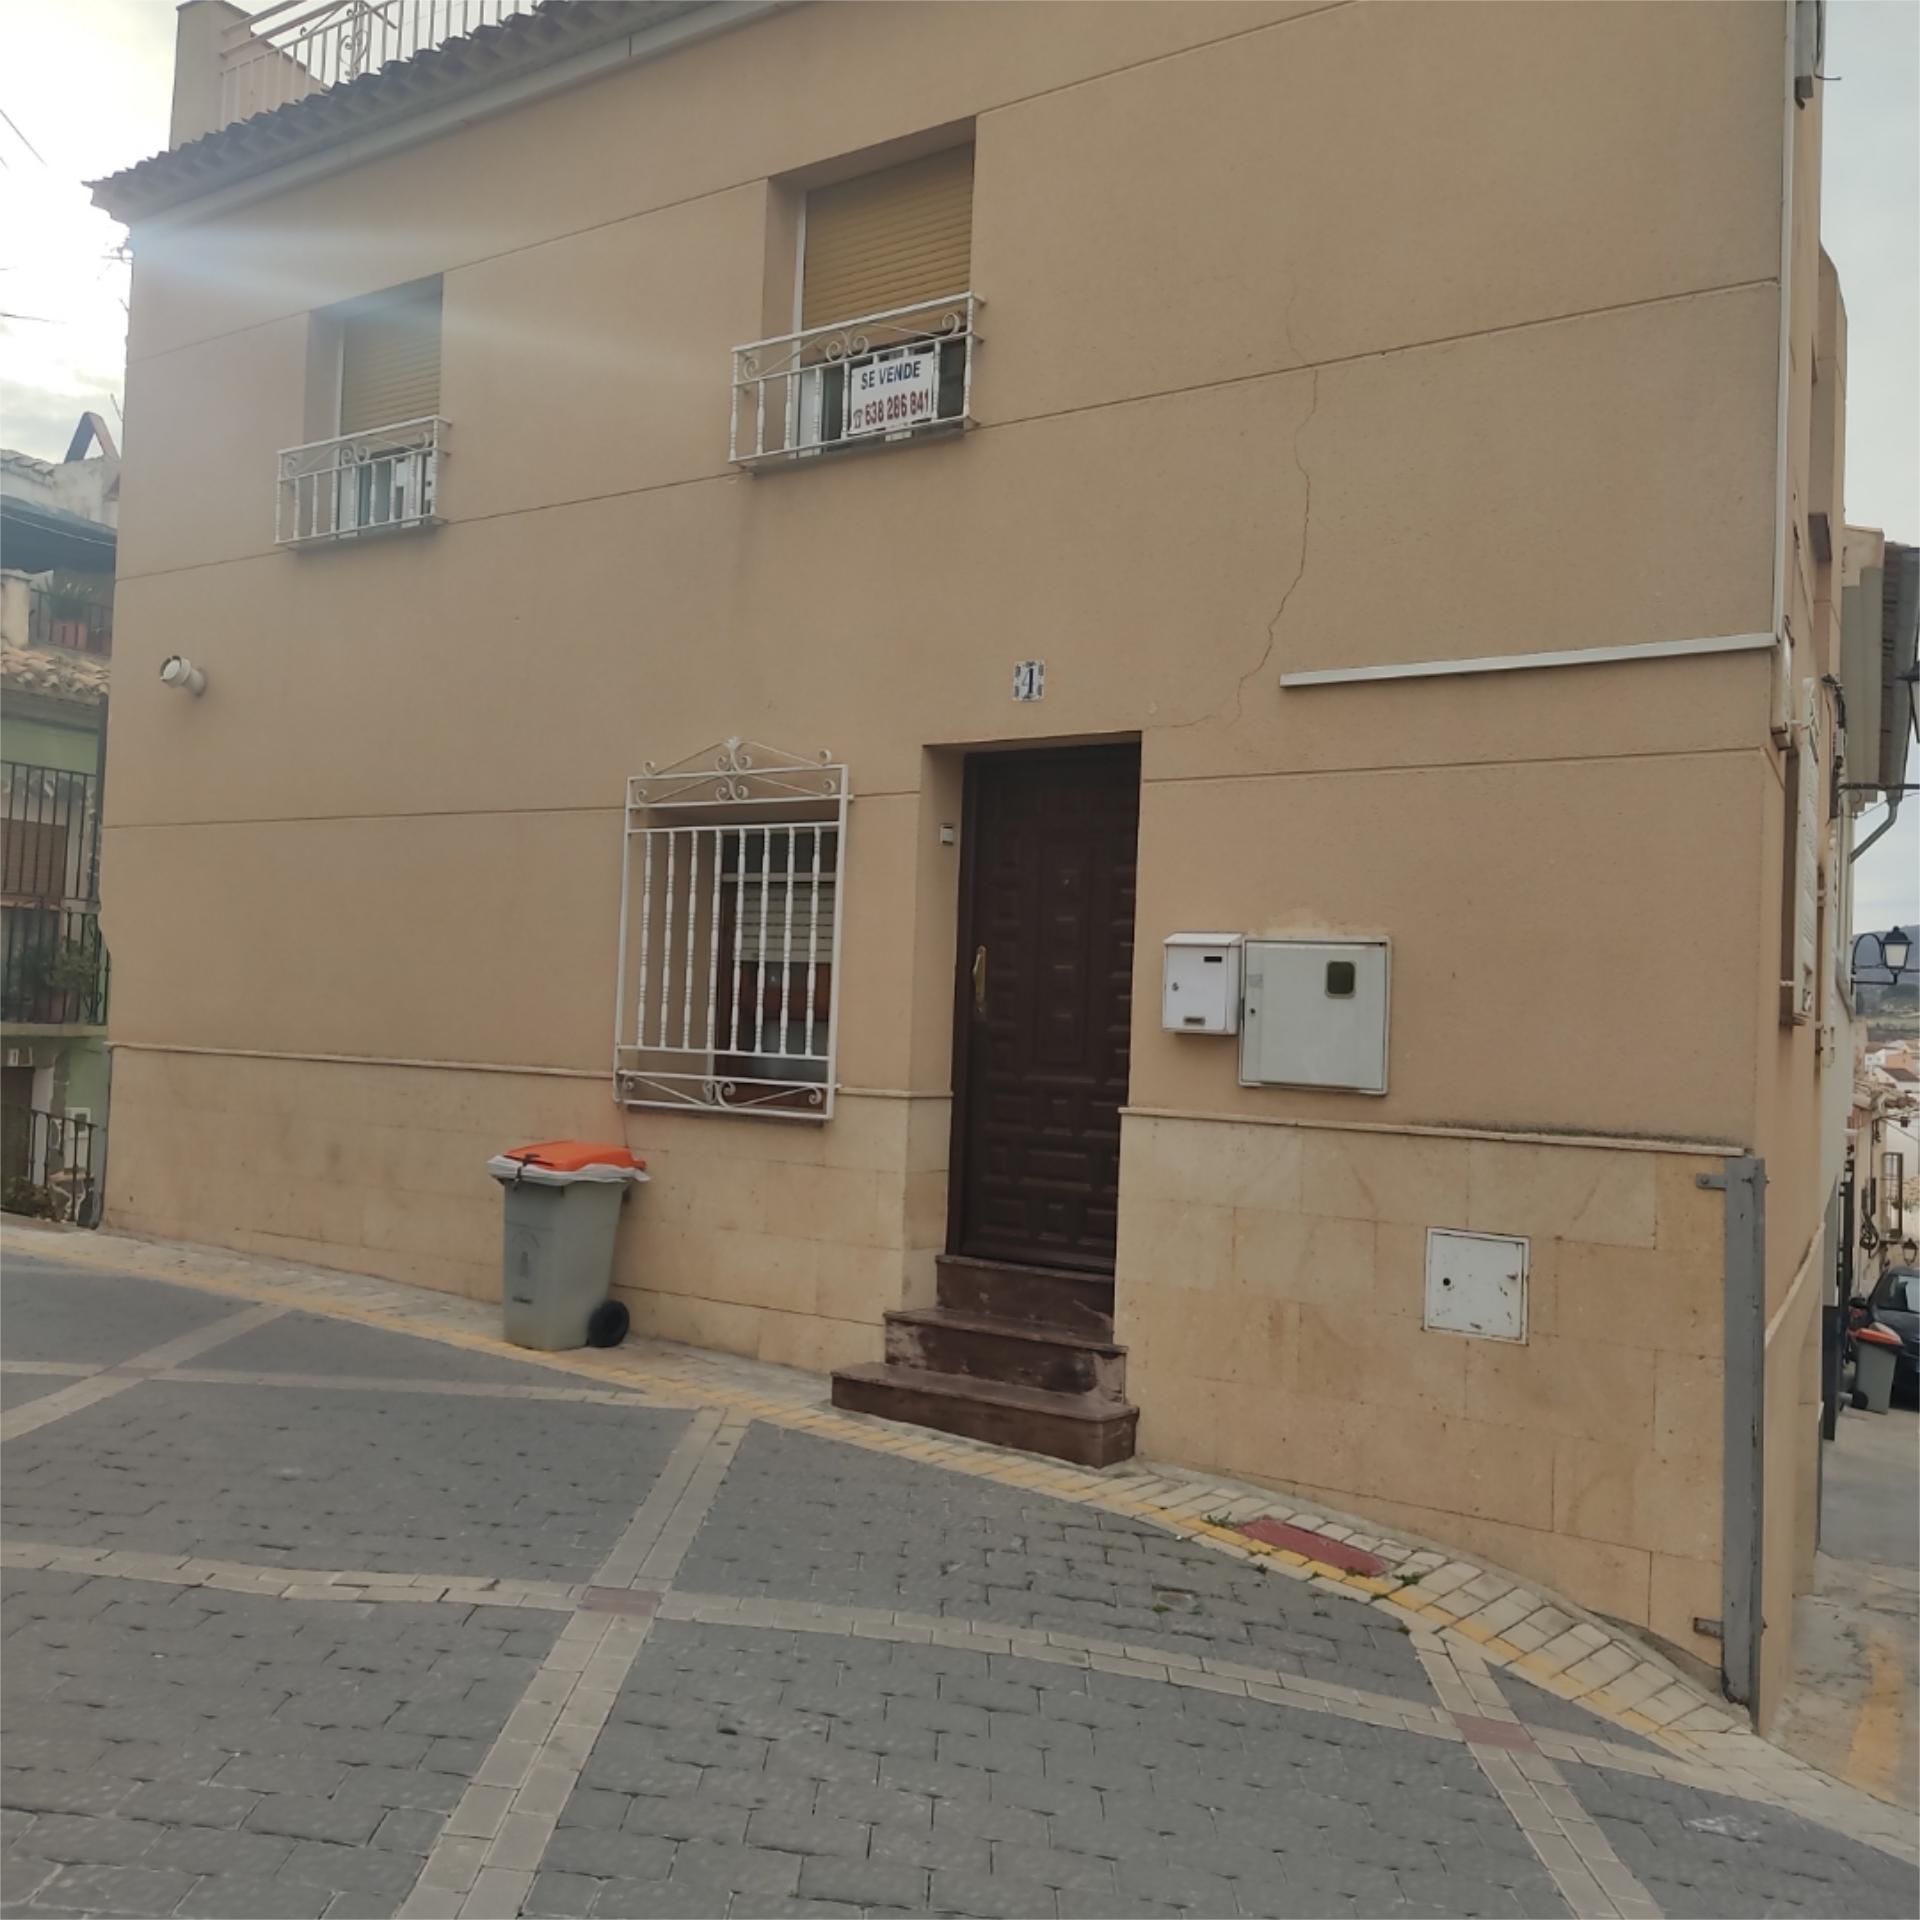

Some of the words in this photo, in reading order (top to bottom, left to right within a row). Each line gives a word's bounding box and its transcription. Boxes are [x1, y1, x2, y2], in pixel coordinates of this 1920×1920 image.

[861, 370, 875, 390] SE
[879, 361, 922, 384] VENDE
[865, 399, 884, 425] 638
[910, 388, 929, 415] 841
